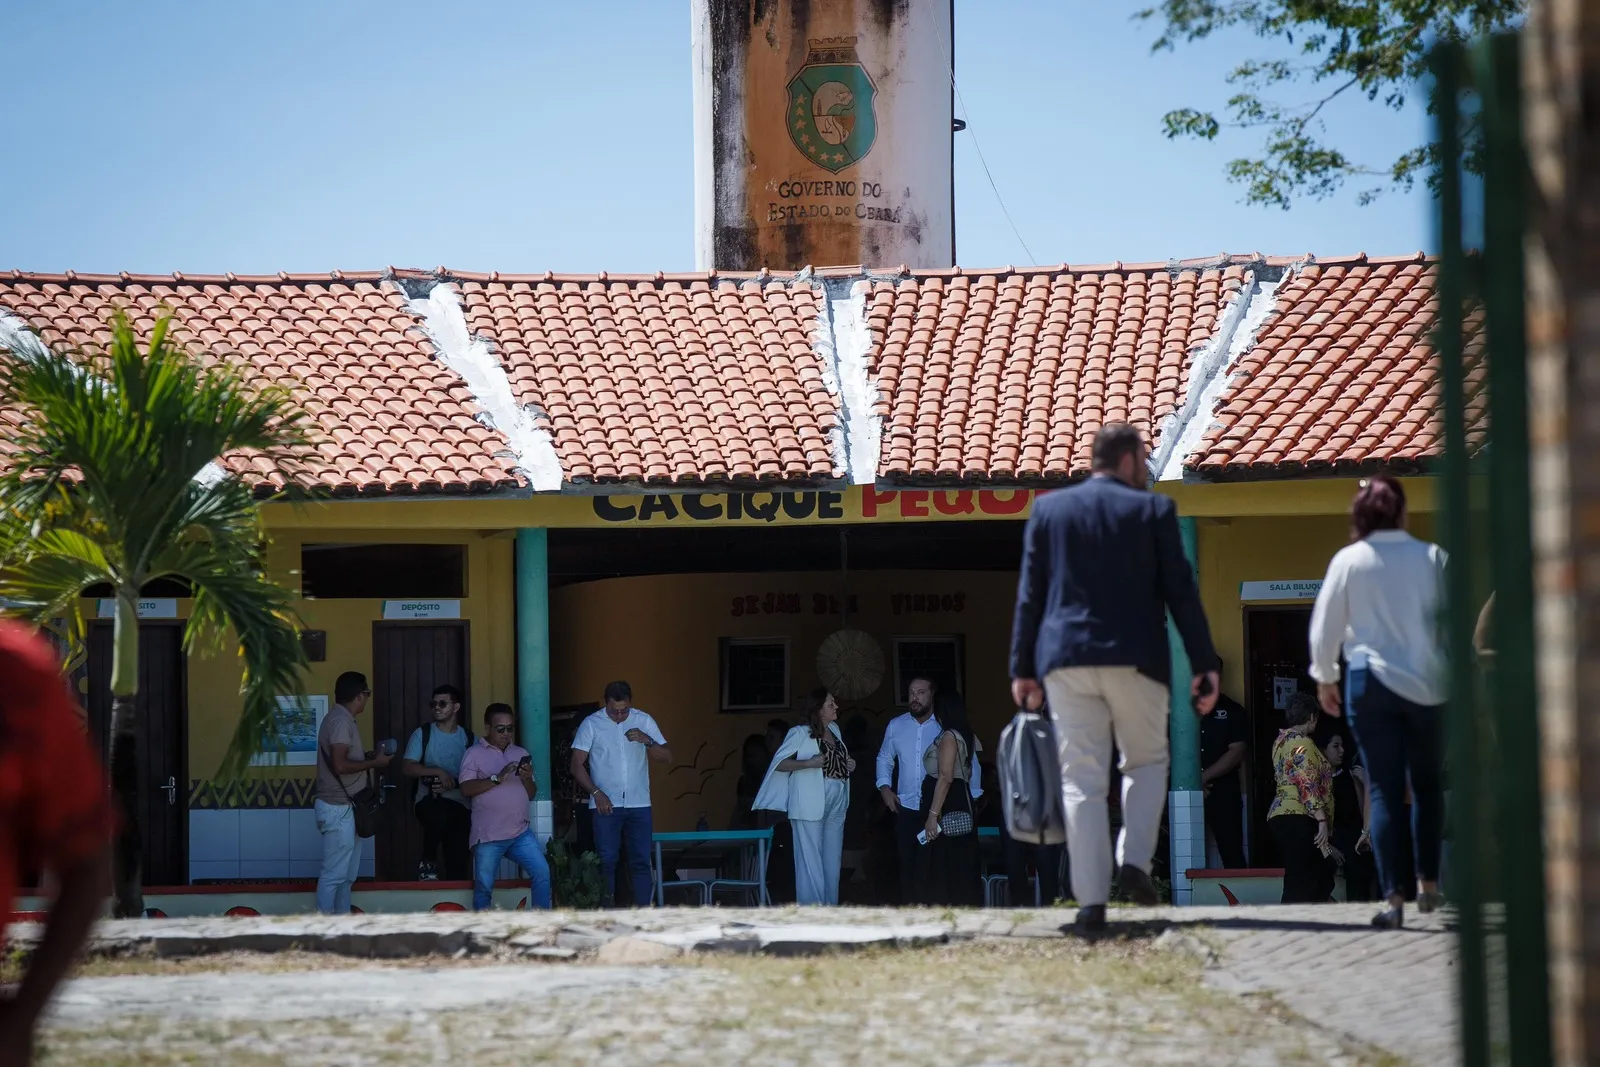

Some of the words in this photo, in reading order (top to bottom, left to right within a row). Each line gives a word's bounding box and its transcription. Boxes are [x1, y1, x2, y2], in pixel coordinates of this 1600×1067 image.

[779, 181, 856, 198] GOVERNO
[862, 182, 881, 198] DO
[768, 203, 830, 221] ESTADO
[835, 206, 850, 216] DO
[593, 491, 843, 522] CACIQUE
[862, 484, 1046, 517] PEQU
[401, 602, 440, 610] DEPÓSITO
